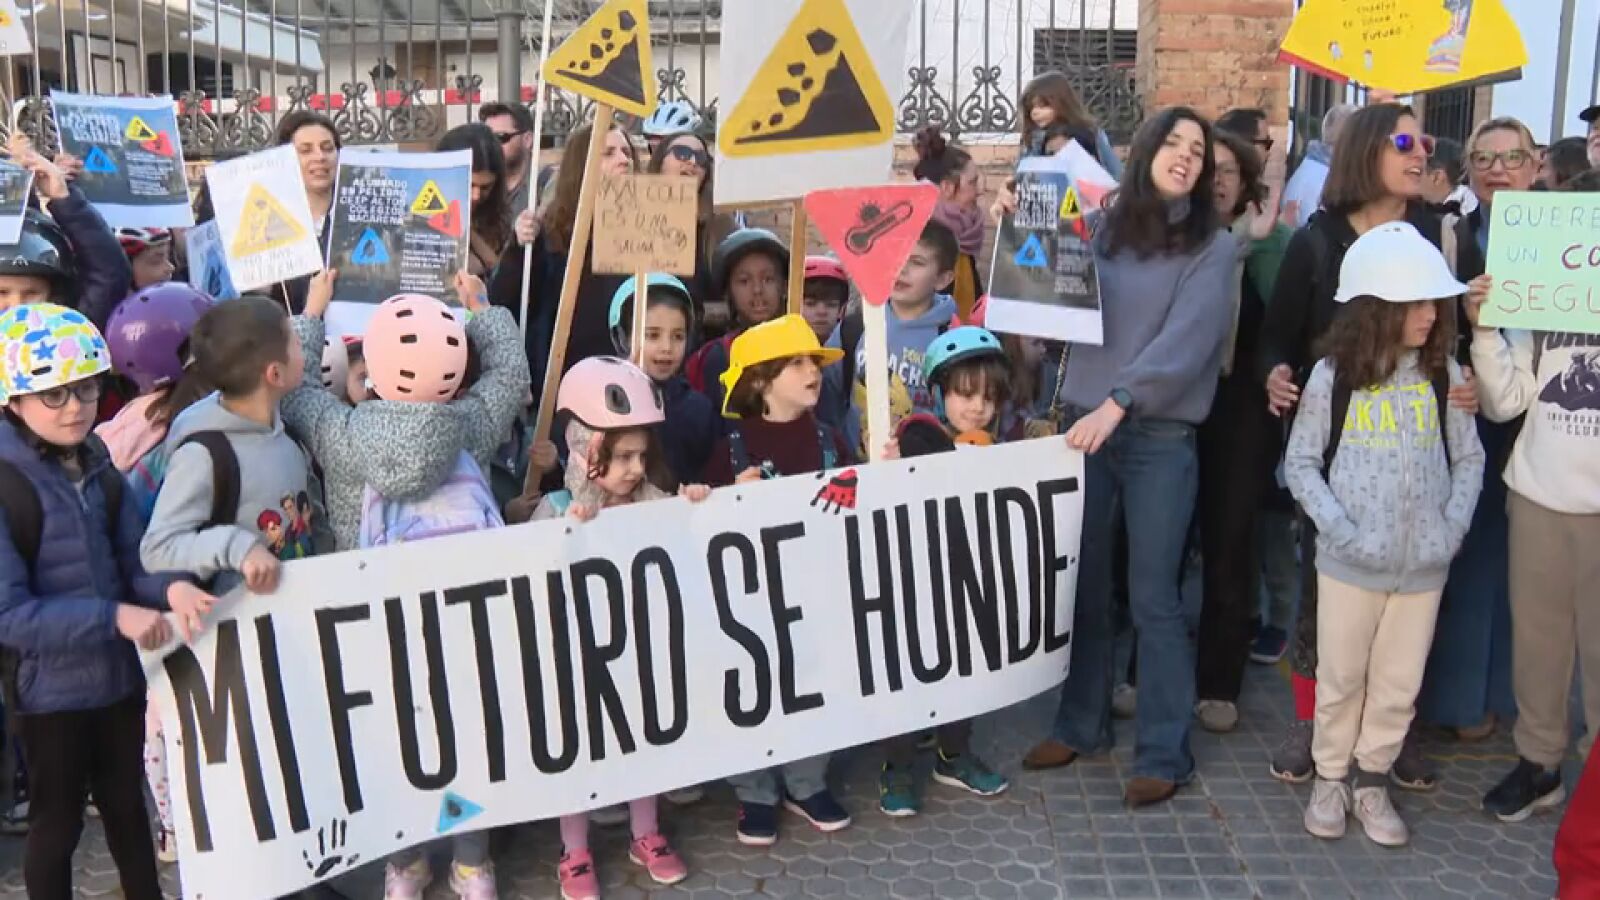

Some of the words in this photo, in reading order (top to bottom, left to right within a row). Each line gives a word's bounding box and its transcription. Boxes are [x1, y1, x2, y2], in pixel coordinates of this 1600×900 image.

[1507, 246, 1538, 263] UN
[163, 613, 310, 853] MI
[315, 547, 688, 815] FUTURO
[706, 520, 824, 728] SE
[844, 476, 1079, 697] HUNDE
